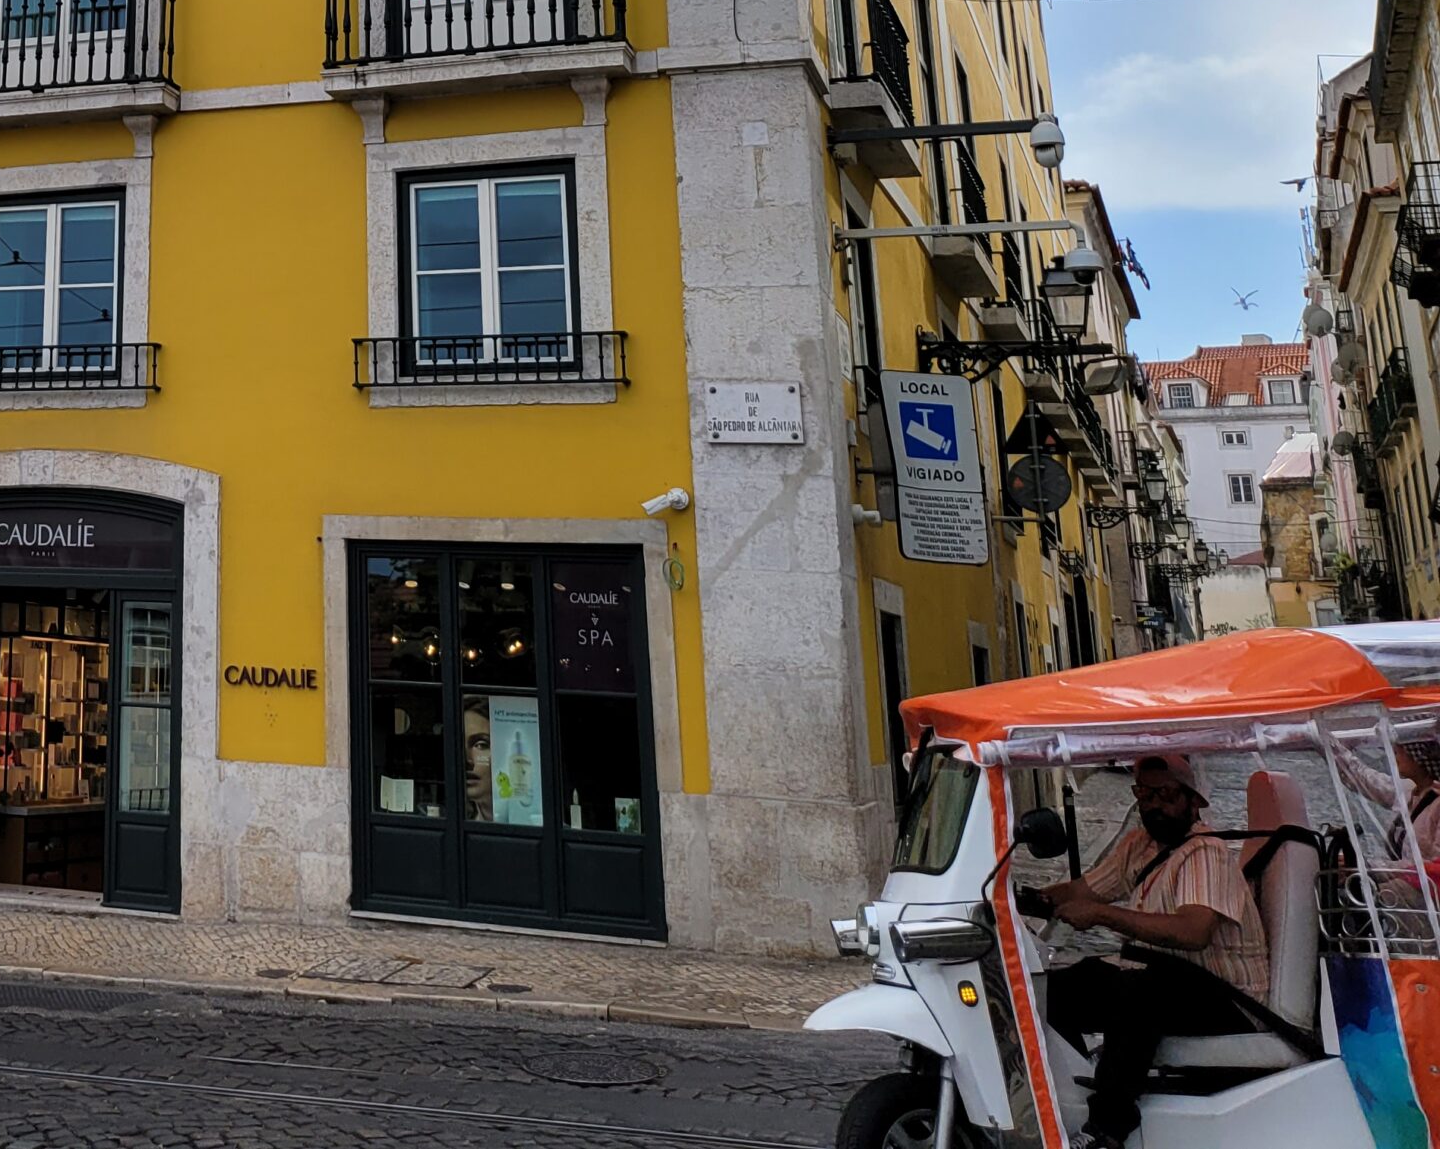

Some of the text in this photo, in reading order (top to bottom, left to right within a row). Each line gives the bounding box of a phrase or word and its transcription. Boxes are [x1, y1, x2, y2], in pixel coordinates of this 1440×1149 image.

[900, 381, 949, 396] LOCAL
[744, 392, 760, 403] RUA
[748, 406, 758, 417] DE
[707, 417, 802, 432] SÃO PEDRO DE ALCÂNTARA
[906, 466, 965, 482] VIGIADO
[578, 629, 613, 646] SPA
